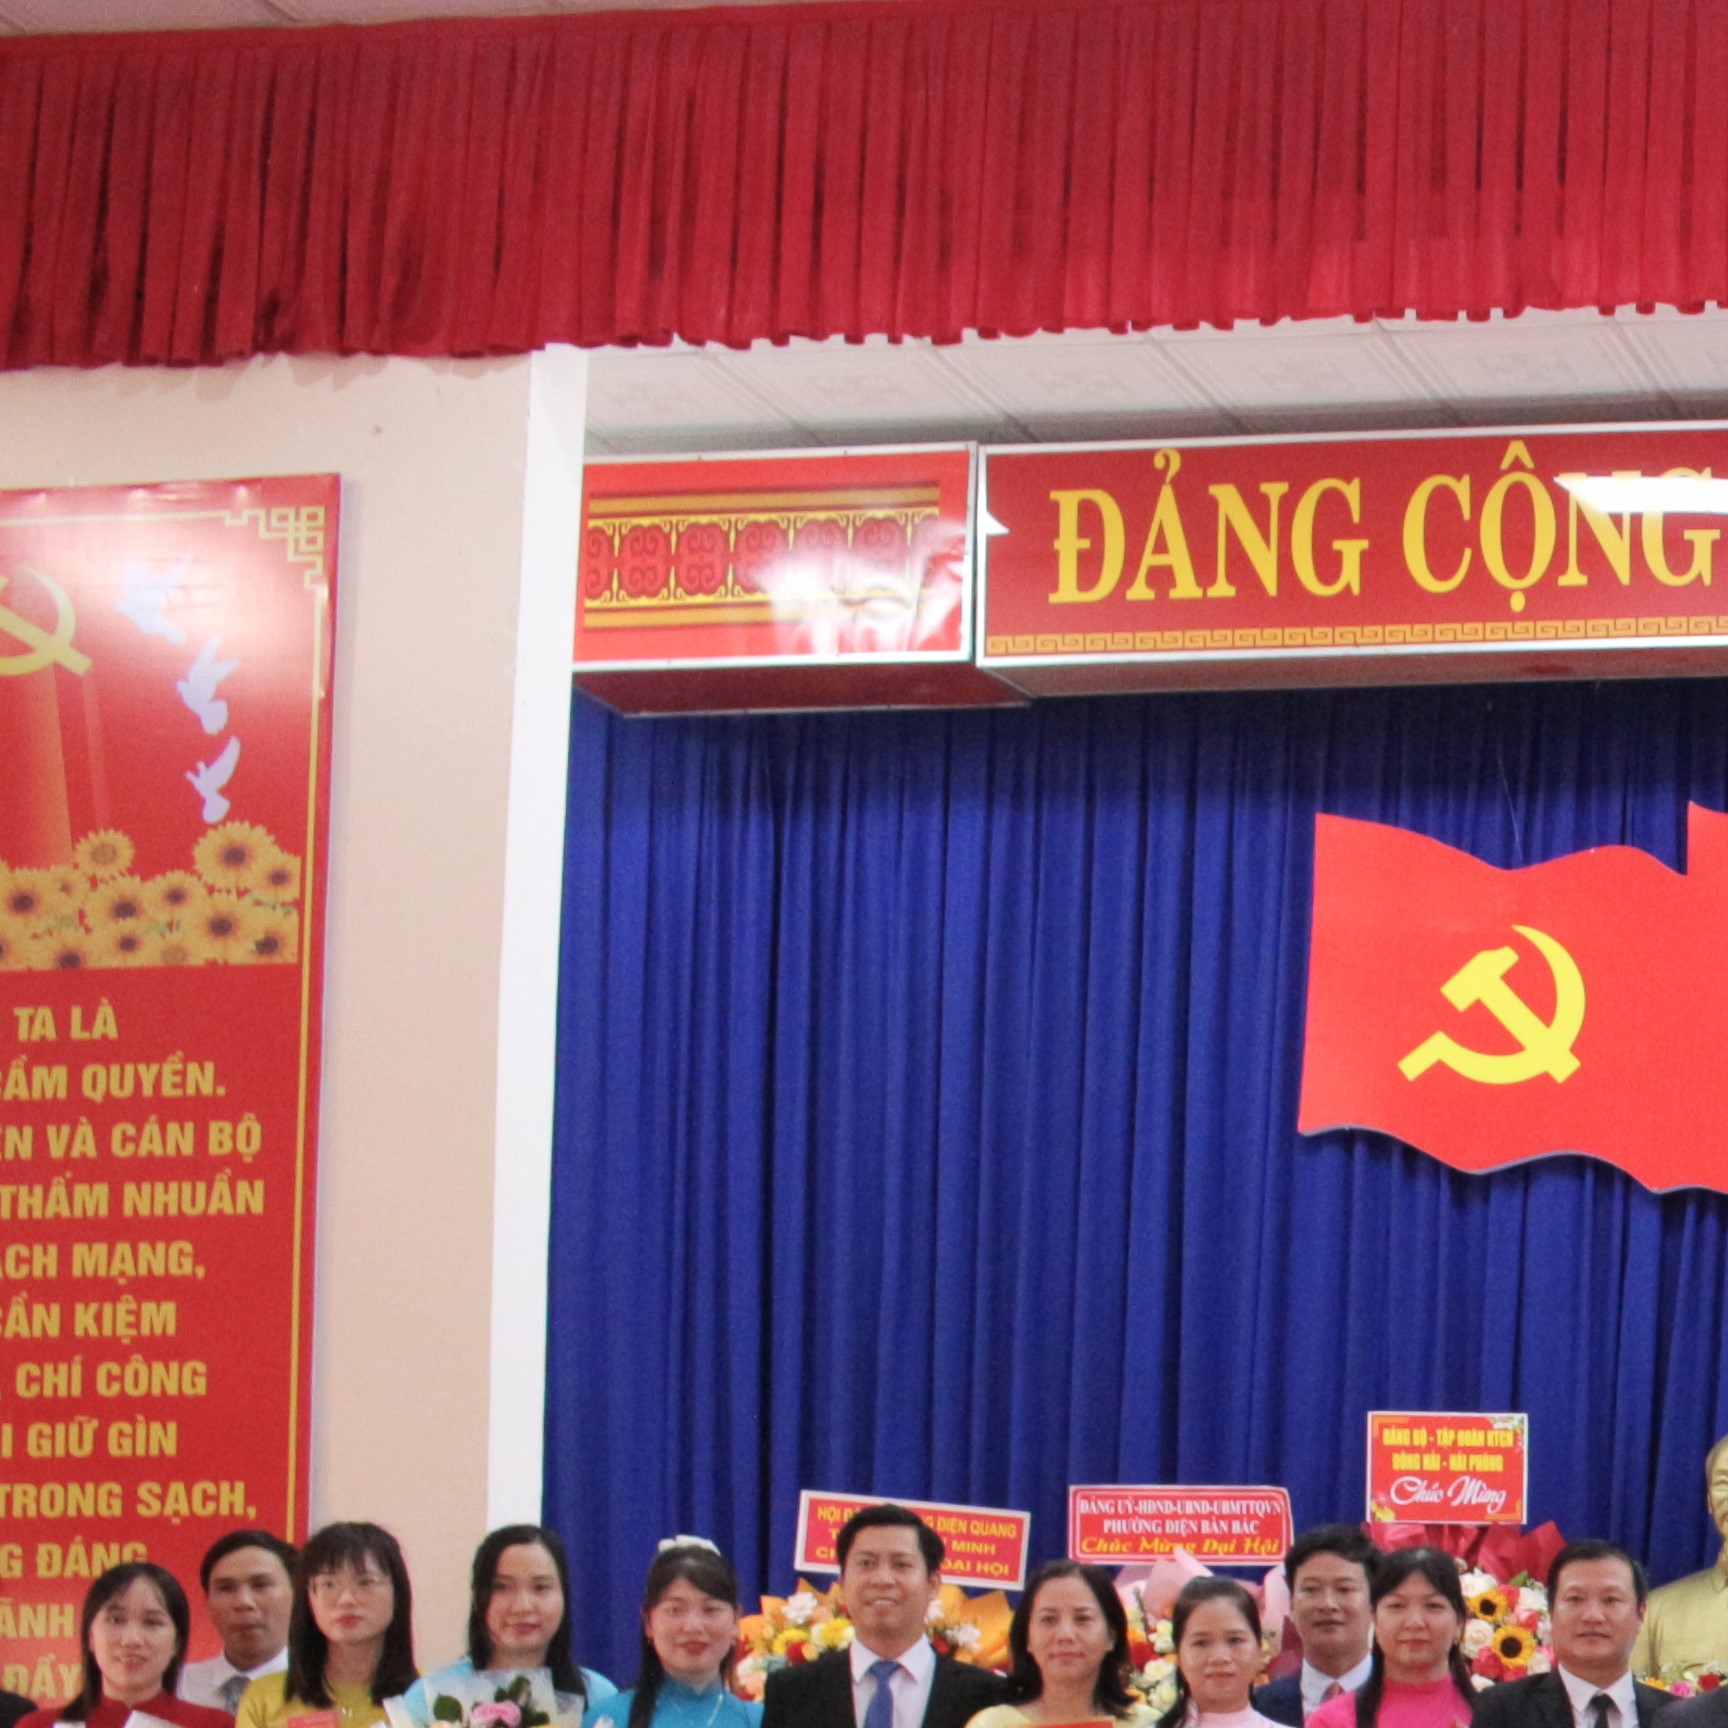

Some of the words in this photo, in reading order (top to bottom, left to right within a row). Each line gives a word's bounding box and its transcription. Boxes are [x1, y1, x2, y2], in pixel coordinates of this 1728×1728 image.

[1053, 447, 1369, 603] ĐẢNG
[1402, 440, 1721, 613] CỘNG
[13, 1006, 57, 1041] TA
[70, 997, 119, 1040] LÀ
[81, 1050, 227, 1104] QUYỀN.
[46, 1115, 98, 1160] VÀ
[110, 1114, 196, 1158] CÁN
[208, 1112, 263, 1164] BỘ
[122, 1168, 266, 1218] NHUẦN
[71, 1240, 207, 1285] MẠNG,
[73, 1294, 178, 1345] KIỆM
[15, 1354, 83, 1399] CHÍ
[95, 1354, 209, 1398] CÔNG
[27, 1415, 100, 1459] GIỮ
[107, 1414, 179, 1459] GÌN
[0, 1481, 124, 1519] TRONG
[136, 1480, 258, 1525] SẠCH,
[1390, 1475, 1444, 1505] Chúc
[1446, 1475, 1507, 1514] Mừng
[951, 1540, 997, 1556] MINH
[969, 1520, 1018, 1540] QUANG
